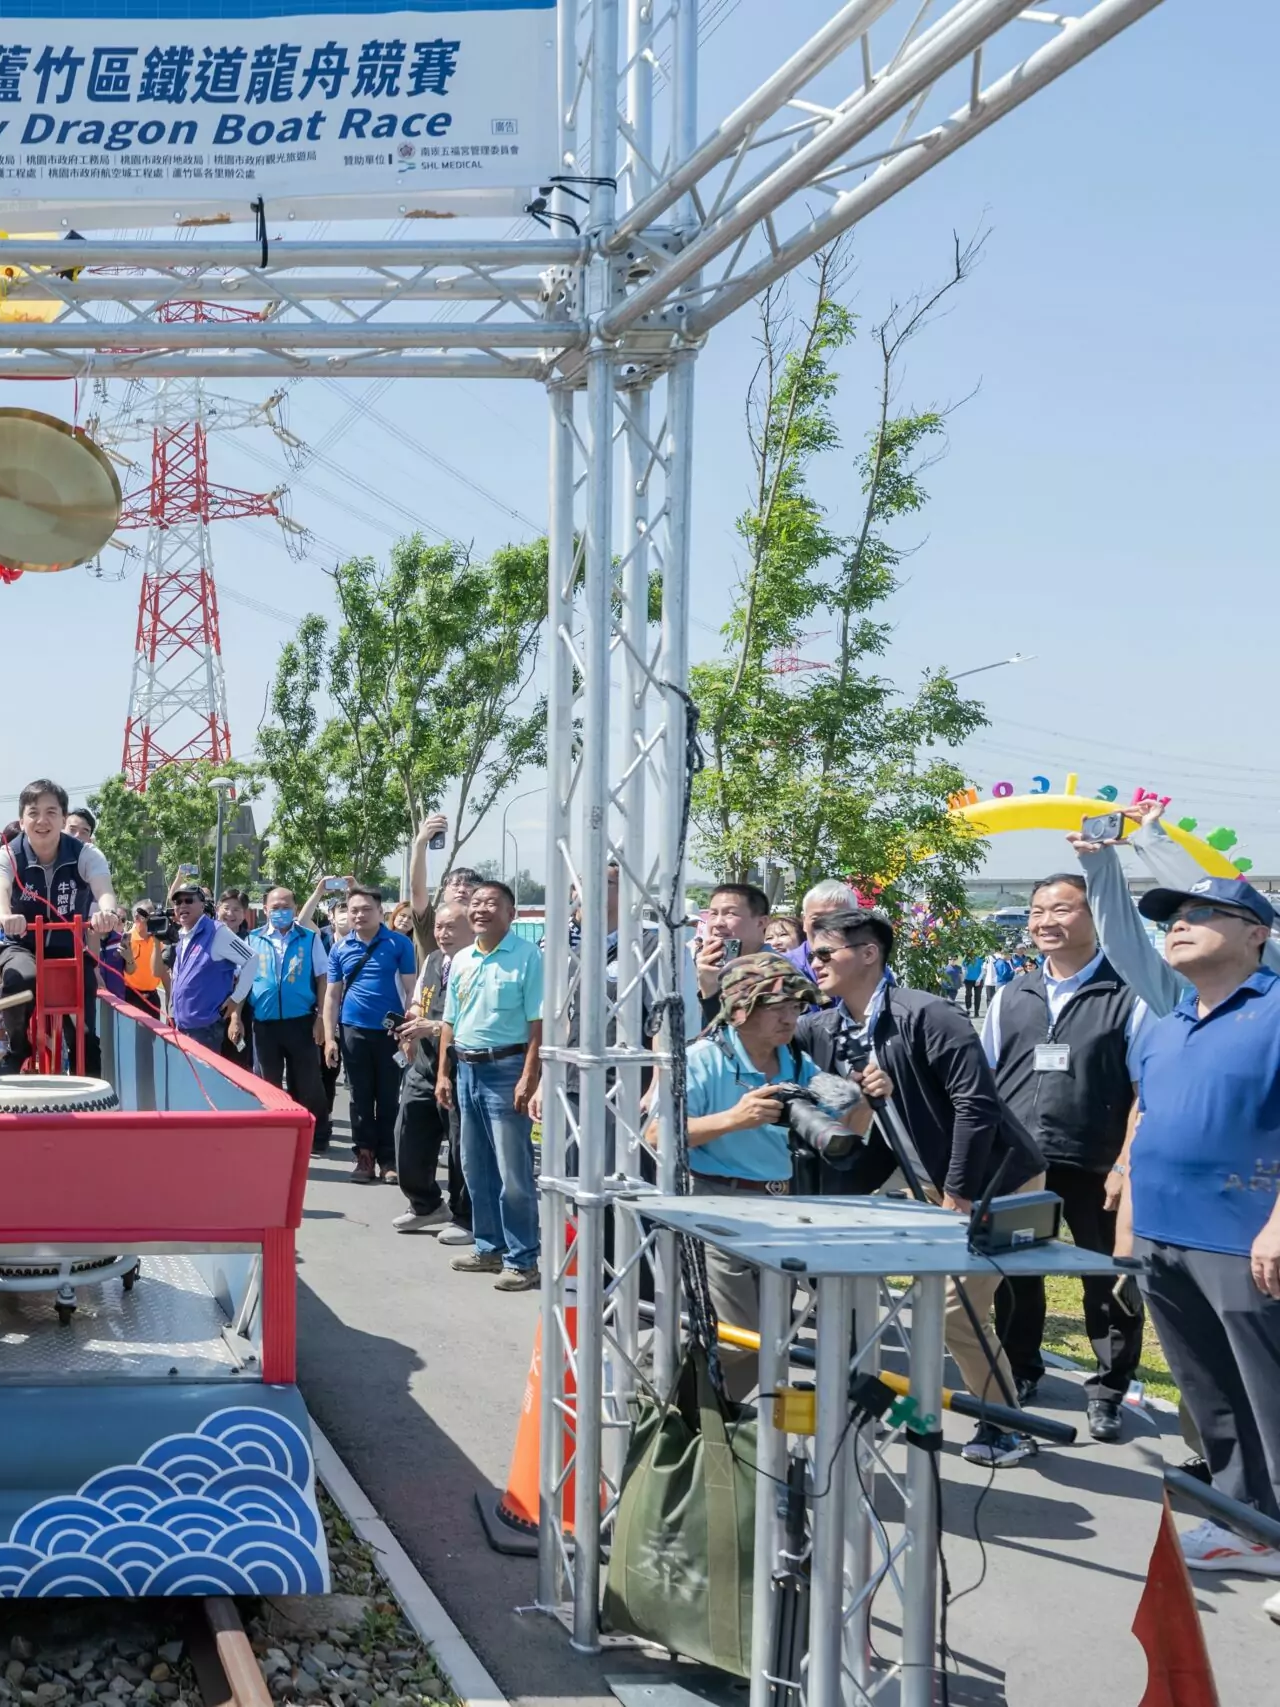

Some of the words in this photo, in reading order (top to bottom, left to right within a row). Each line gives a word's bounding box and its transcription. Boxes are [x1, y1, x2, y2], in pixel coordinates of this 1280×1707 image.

[20, 113, 198, 151] Dragon
[212, 110, 326, 146] Boat
[338, 108, 452, 140] Race
[495, 120, 514, 133] 廣告
[420, 145, 519, 157] 南崁五福宮管理委員會
[26, 154, 110, 166] 桃園市政府工務局
[120, 153, 203, 165] 桃園市政府地政局
[214, 150, 317, 166] 桃園市政府觀光旅遊局
[421, 161, 439, 170] SHL
[442, 160, 483, 170] MEDICAL
[48, 167, 163, 179] 桃園市政府航空城工程處
[172, 167, 255, 180] 蘆竹區各里辦公處
